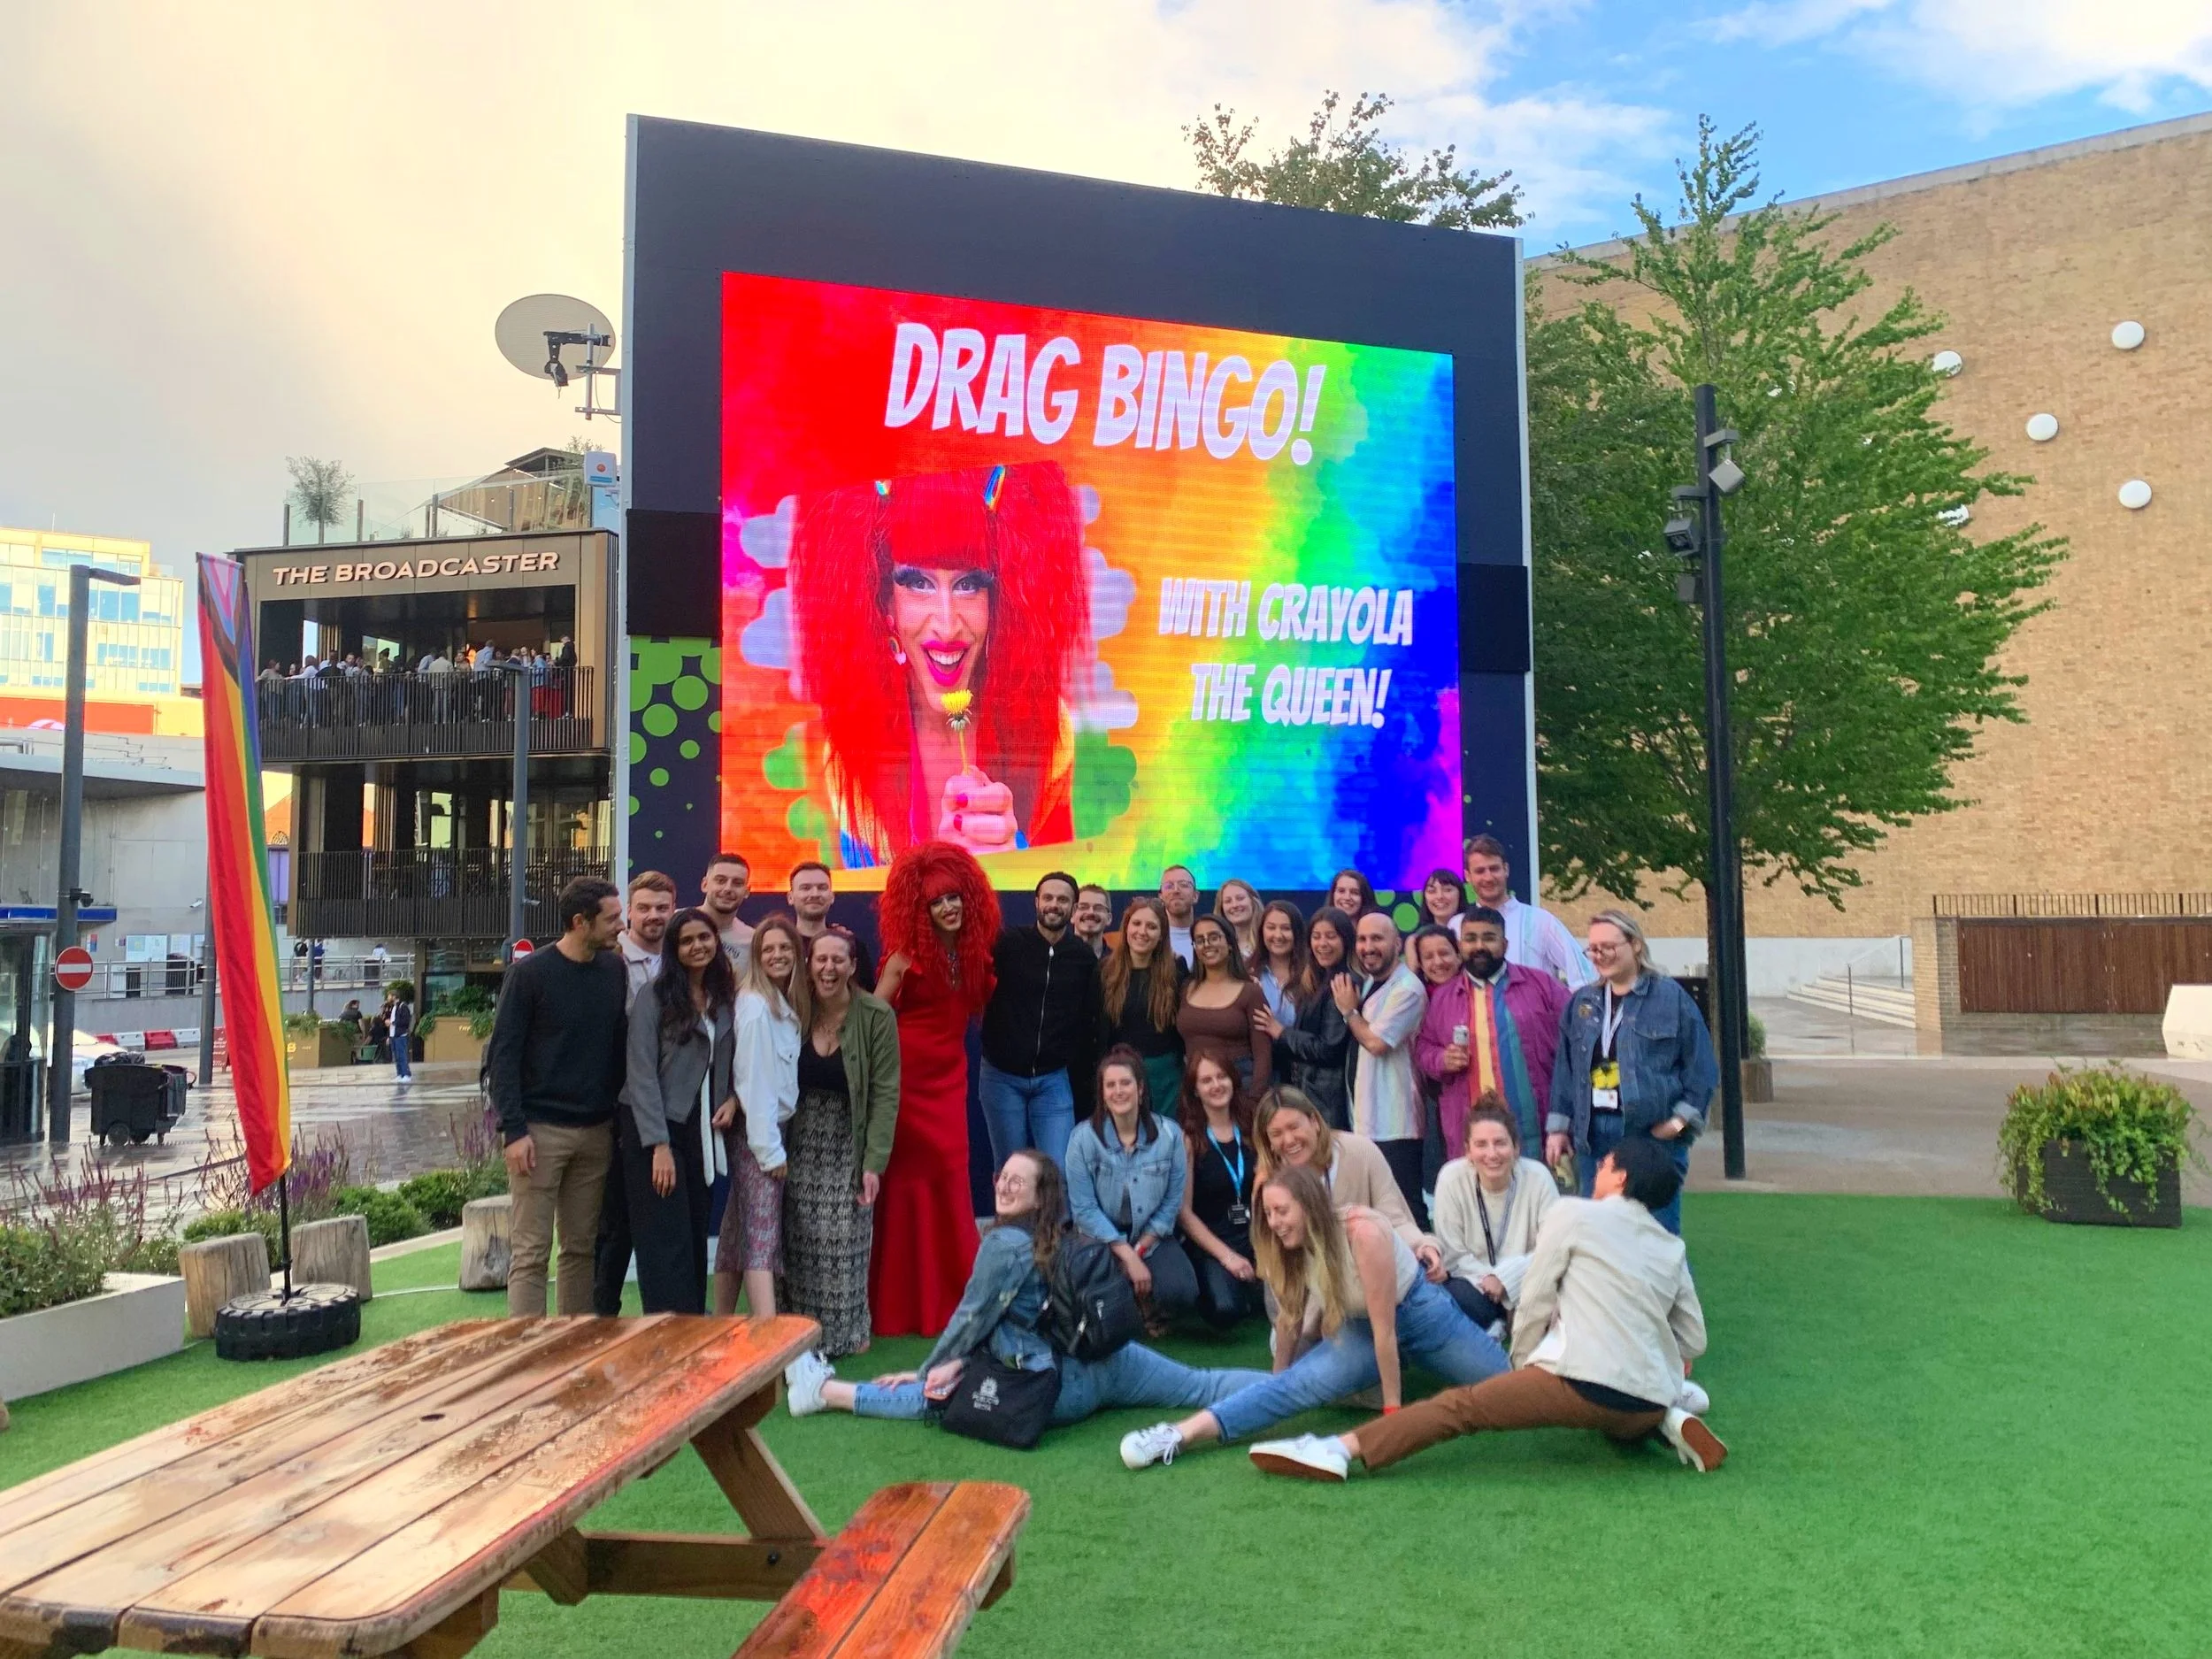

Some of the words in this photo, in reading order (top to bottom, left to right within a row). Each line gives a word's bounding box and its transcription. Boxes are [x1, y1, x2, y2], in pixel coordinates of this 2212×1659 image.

[884, 321, 1081, 446] DRAG
[1093, 343, 1327, 467] BINGO!
[273, 566, 328, 586] THE
[334, 551, 559, 583] BROADCASTER
[1158, 577, 1250, 639] WITH
[1258, 582, 1413, 647] CRAYOLA
[1191, 663, 1255, 722] THE
[1261, 664, 1393, 729] QUEEN!
